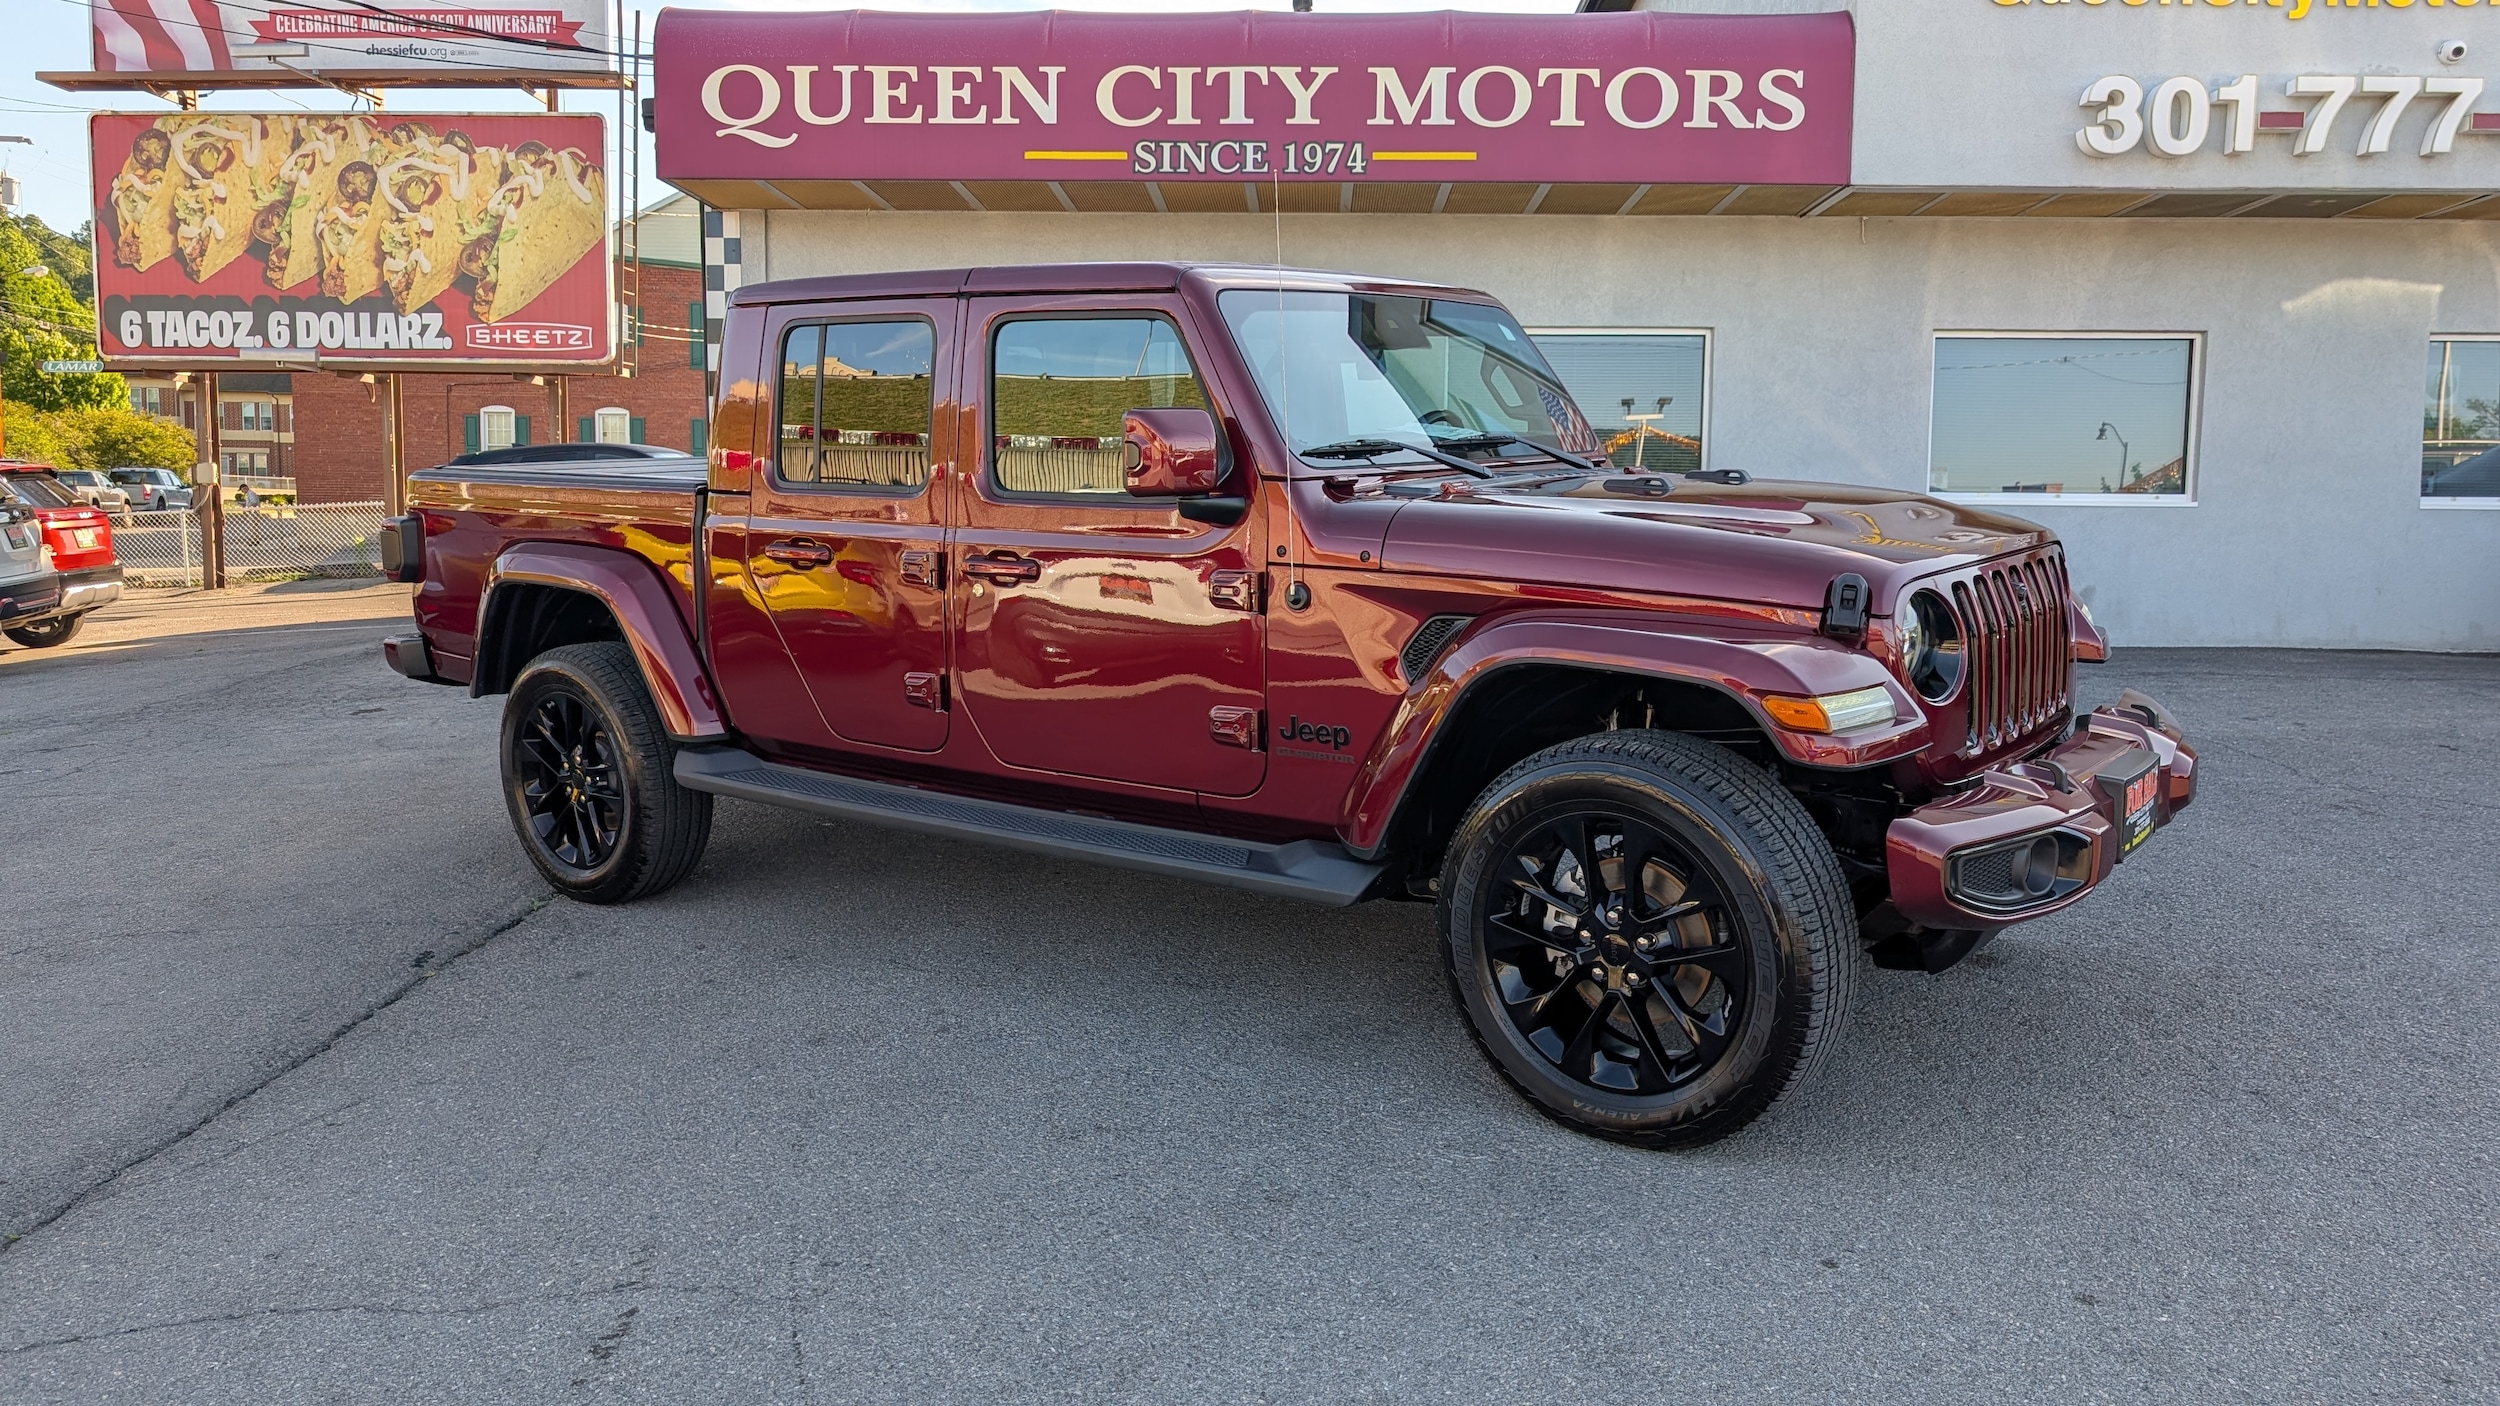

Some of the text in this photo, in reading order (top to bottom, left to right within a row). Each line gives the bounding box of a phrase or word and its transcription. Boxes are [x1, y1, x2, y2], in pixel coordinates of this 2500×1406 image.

[276, 15, 358, 33] CELEBRATING
[467, 15, 557, 34] ANNIVERSARY!
[365, 43, 447, 59] chessiefcu.org
[701, 64, 1806, 148] QUEEN CITY MOTORS
[1133, 141, 1367, 175] SINCE 1974
[119, 310, 453, 350] 6 TACOZ. 6 DOLLARZ.
[474, 327, 588, 346] SHEETZ
[47, 362, 97, 371] LAMAR
[1279, 715, 1351, 750] Jeep
[1572, 1098, 1641, 1121] ALENZA
